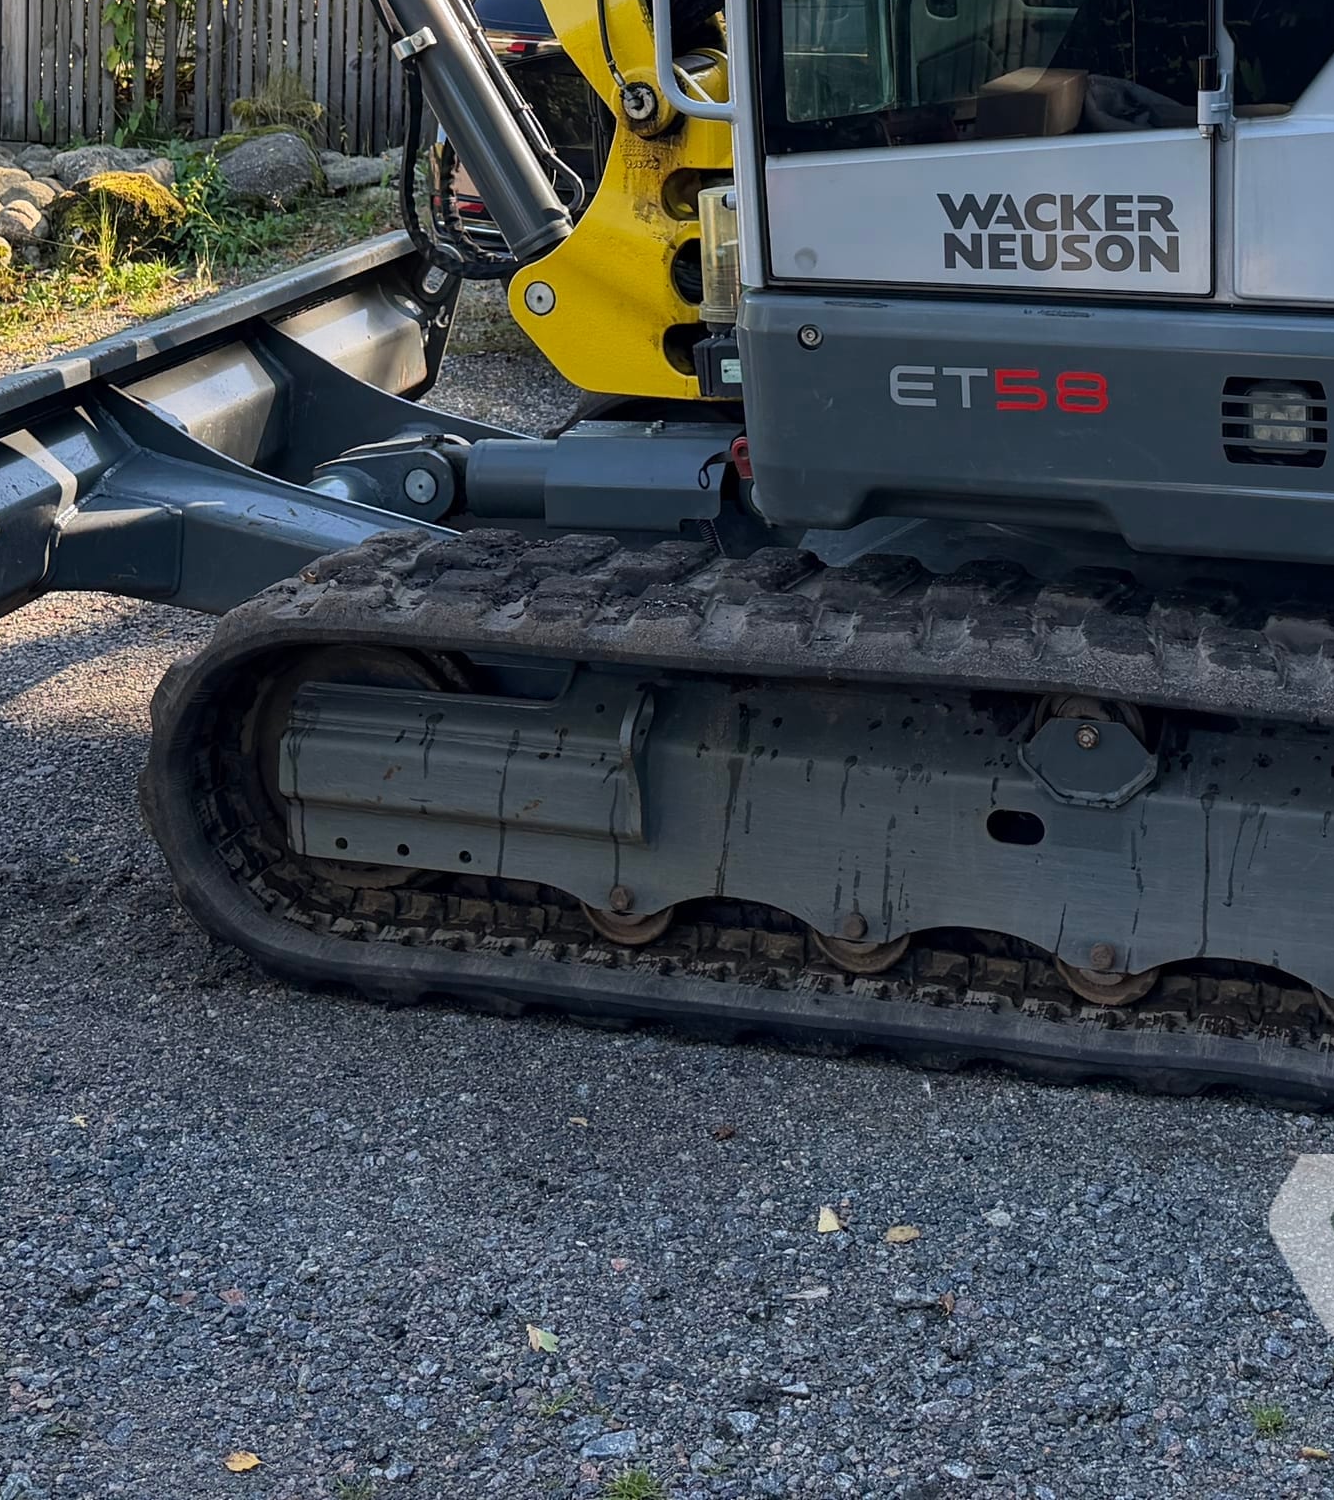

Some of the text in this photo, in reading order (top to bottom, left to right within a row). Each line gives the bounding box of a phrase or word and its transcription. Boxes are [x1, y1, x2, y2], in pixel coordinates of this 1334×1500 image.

[936, 193, 1179, 232] WACKER
[944, 233, 1180, 273] NEUSON
[889, 365, 1109, 414] ET58
